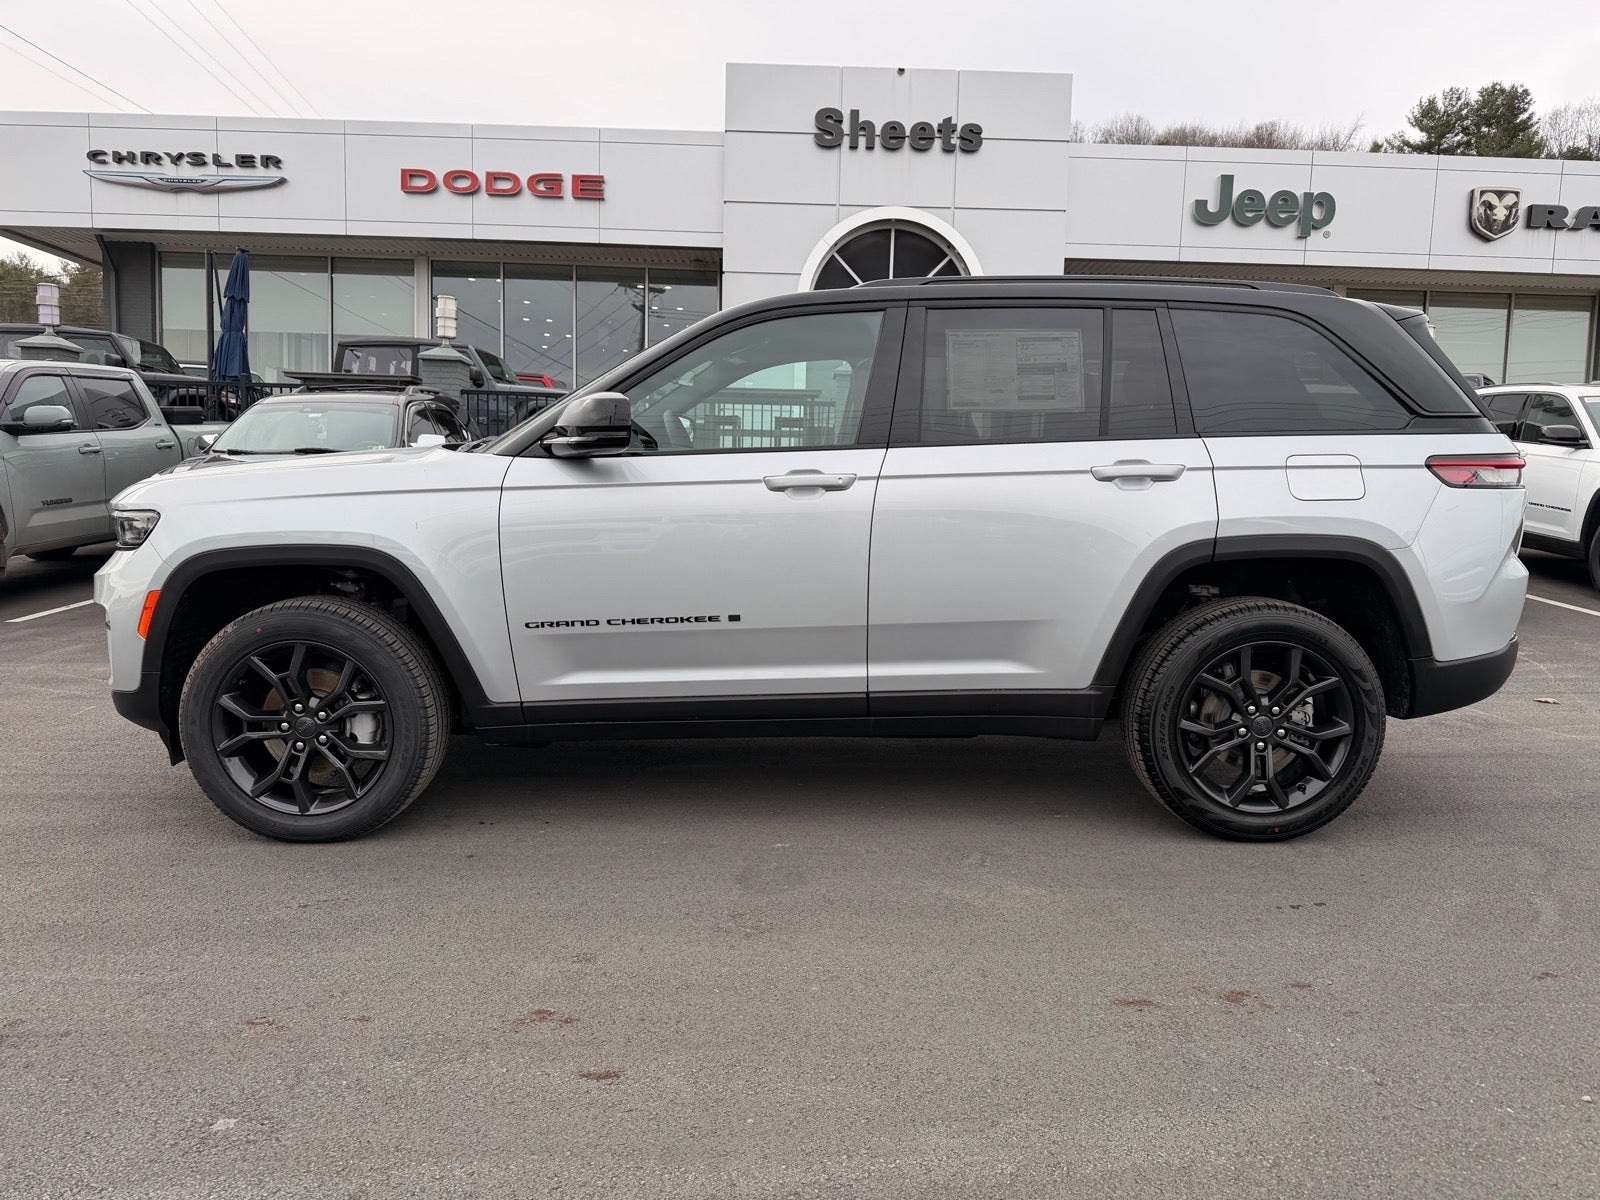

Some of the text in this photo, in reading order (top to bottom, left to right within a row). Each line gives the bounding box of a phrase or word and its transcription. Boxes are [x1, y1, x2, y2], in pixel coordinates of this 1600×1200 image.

[814, 107, 983, 152] Sheets
[86, 149, 283, 169] CHRYSLER
[400, 168, 605, 200] DODGE
[1193, 174, 1336, 239] Jeep
[524, 615, 721, 629] GRAND CHEROKEE
